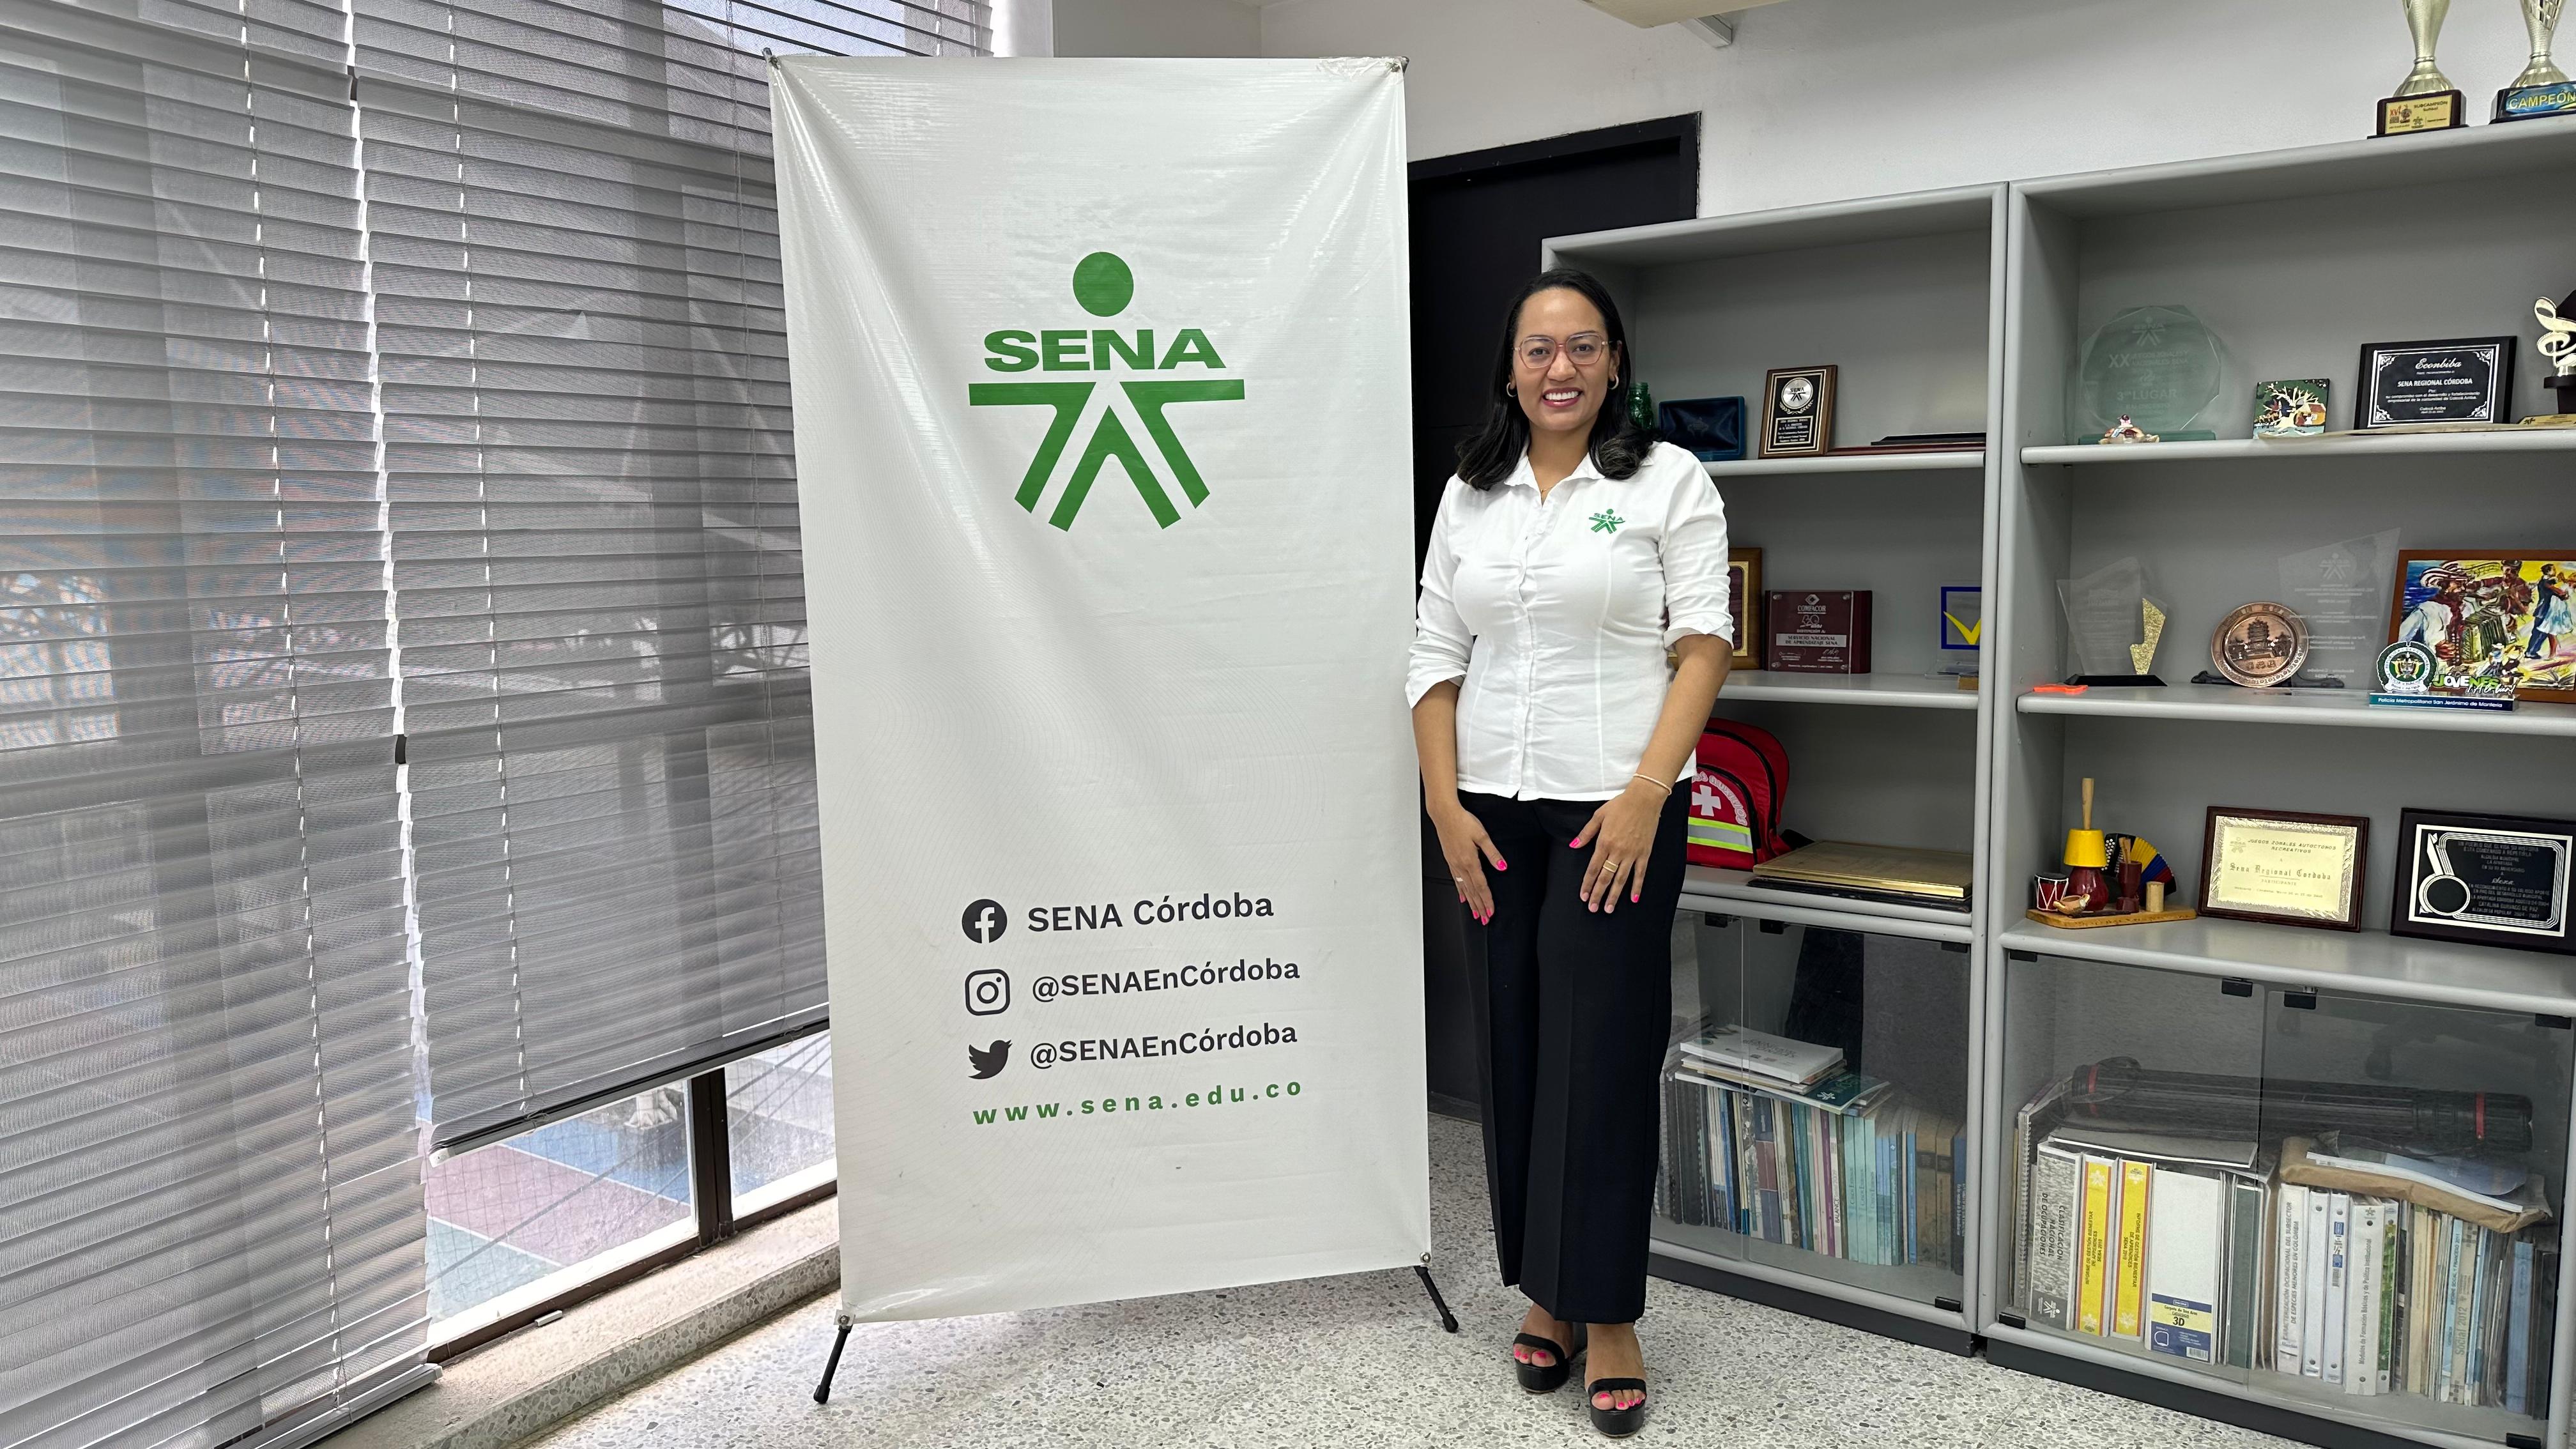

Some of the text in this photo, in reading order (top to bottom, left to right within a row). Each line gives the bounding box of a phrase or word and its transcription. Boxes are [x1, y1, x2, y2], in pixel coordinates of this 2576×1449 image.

[2509, 89, 2576, 109] CAMPEÓN
[984, 328, 1226, 372] SENA
[2133, 389, 2177, 400] LUGAR
[2432, 673, 2501, 688] JÓVENES
[2230, 862, 2331, 880] Sena Regional Cordoba
[1028, 892, 1273, 932] SENA Córdoba
[1032, 958, 1300, 1002] @SENAEnCórdoba
[1031, 1022, 1298, 1069] @SENAEnCórdoba
[973, 1081, 1301, 1124] www.sena.edu.co
[2039, 1193, 2048, 1255] DE OCUPACIONES
[2293, 1252, 2298, 1261] EN
[2173, 1316, 2185, 1326] 3D
[2458, 1307, 2467, 1326] 2012
[2455, 1329, 2466, 1355] Social
